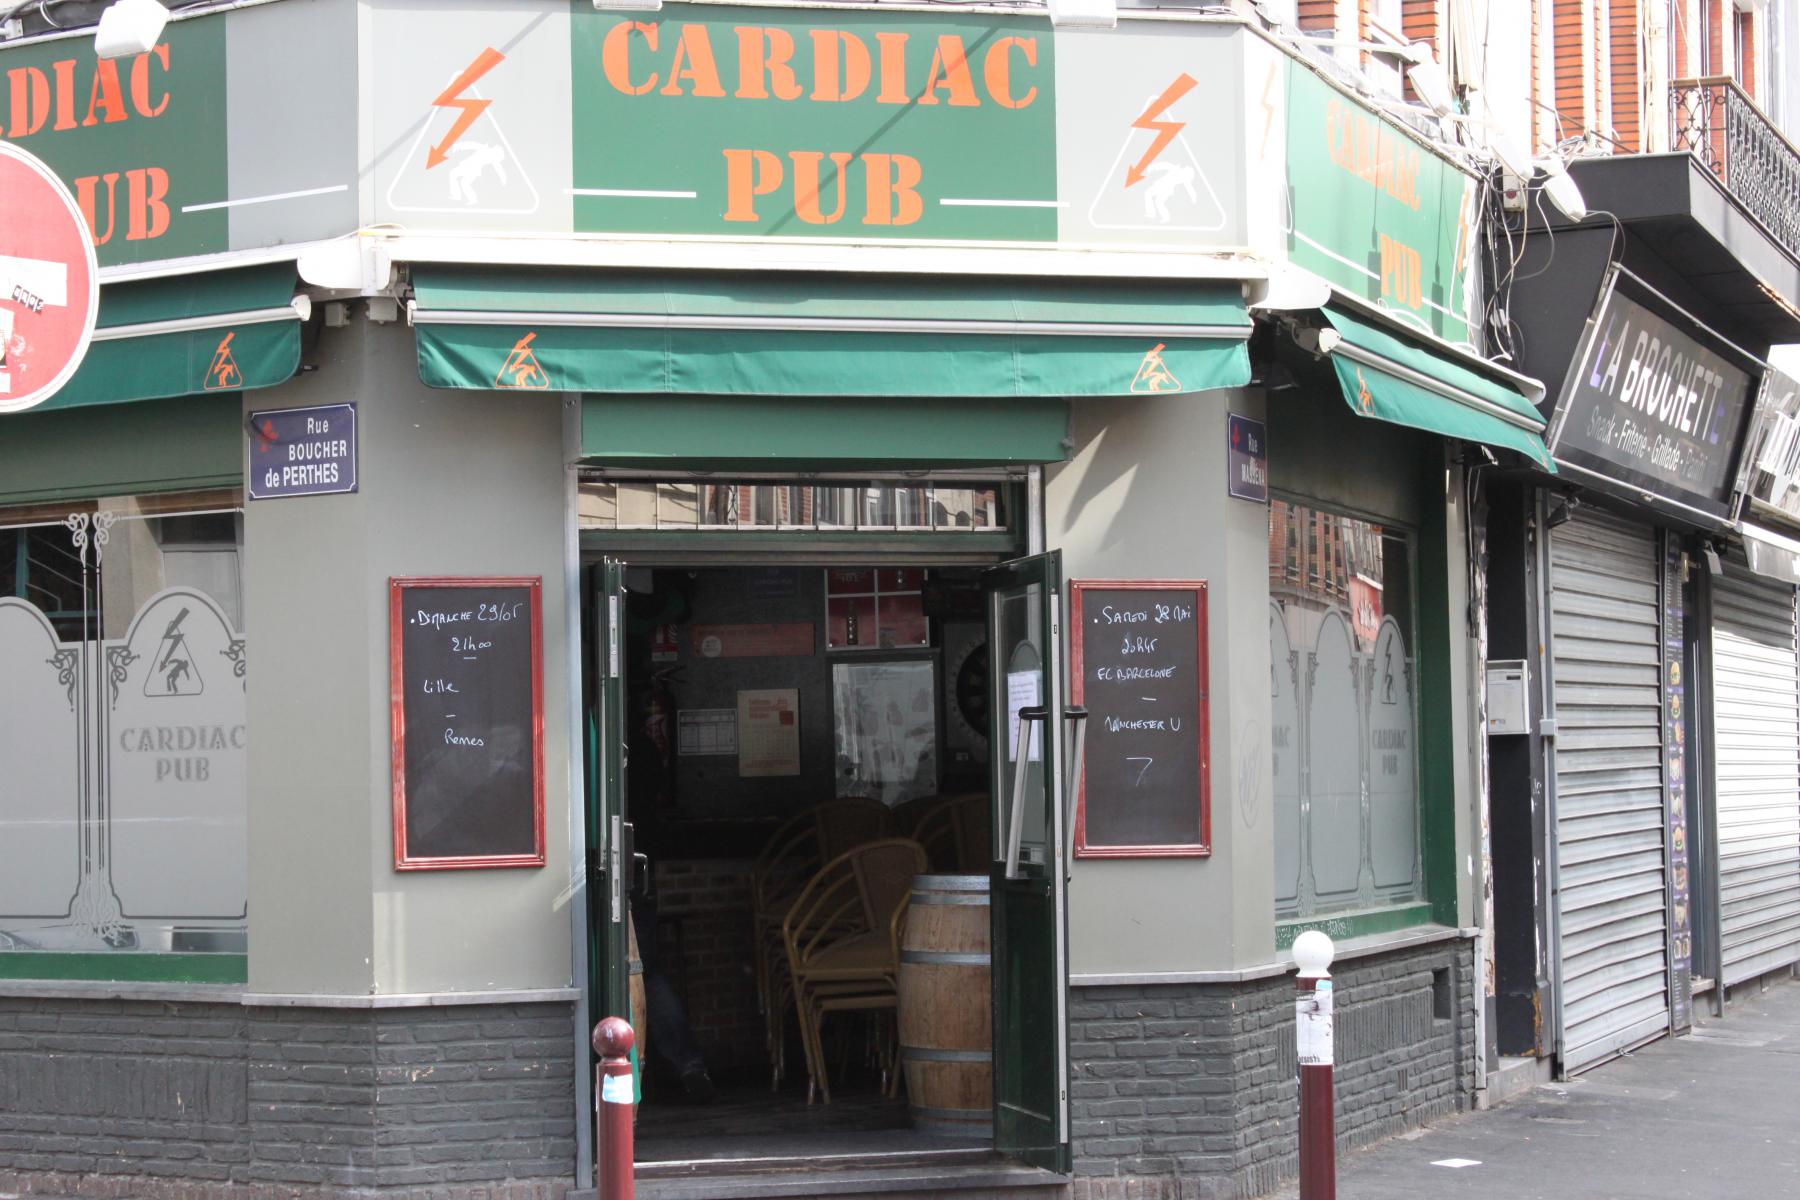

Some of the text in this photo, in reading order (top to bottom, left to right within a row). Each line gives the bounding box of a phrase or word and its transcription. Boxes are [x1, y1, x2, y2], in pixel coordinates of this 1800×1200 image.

[601, 20, 1038, 110] CARDIAC
[0, 42, 170, 139] DIAC
[1327, 98, 1420, 213] CARDIAC
[722, 148, 924, 226] PUB
[74, 166, 171, 247] UB
[1379, 231, 1423, 311] PUB
[1590, 311, 1630, 397] LA
[1620, 329, 1730, 446] BROCHETTE
[307, 417, 329, 434] Rue
[1586, 404, 1616, 445] Snack
[1617, 418, 1648, 458] Friterie
[1651, 433, 1680, 472] Grillade
[288, 439, 348, 461] BOUCHER
[1247, 432, 1259, 453] Rue
[265, 462, 339, 488] de PERTHES
[1155, 603, 1170, 624] 28
[423, 678, 460, 694] Lille
[1116, 665, 1177, 682] BARCELONE
[120, 724, 246, 752] CARDIAC
[1170, 717, 1181, 732] U
[154, 756, 210, 782] PUB
